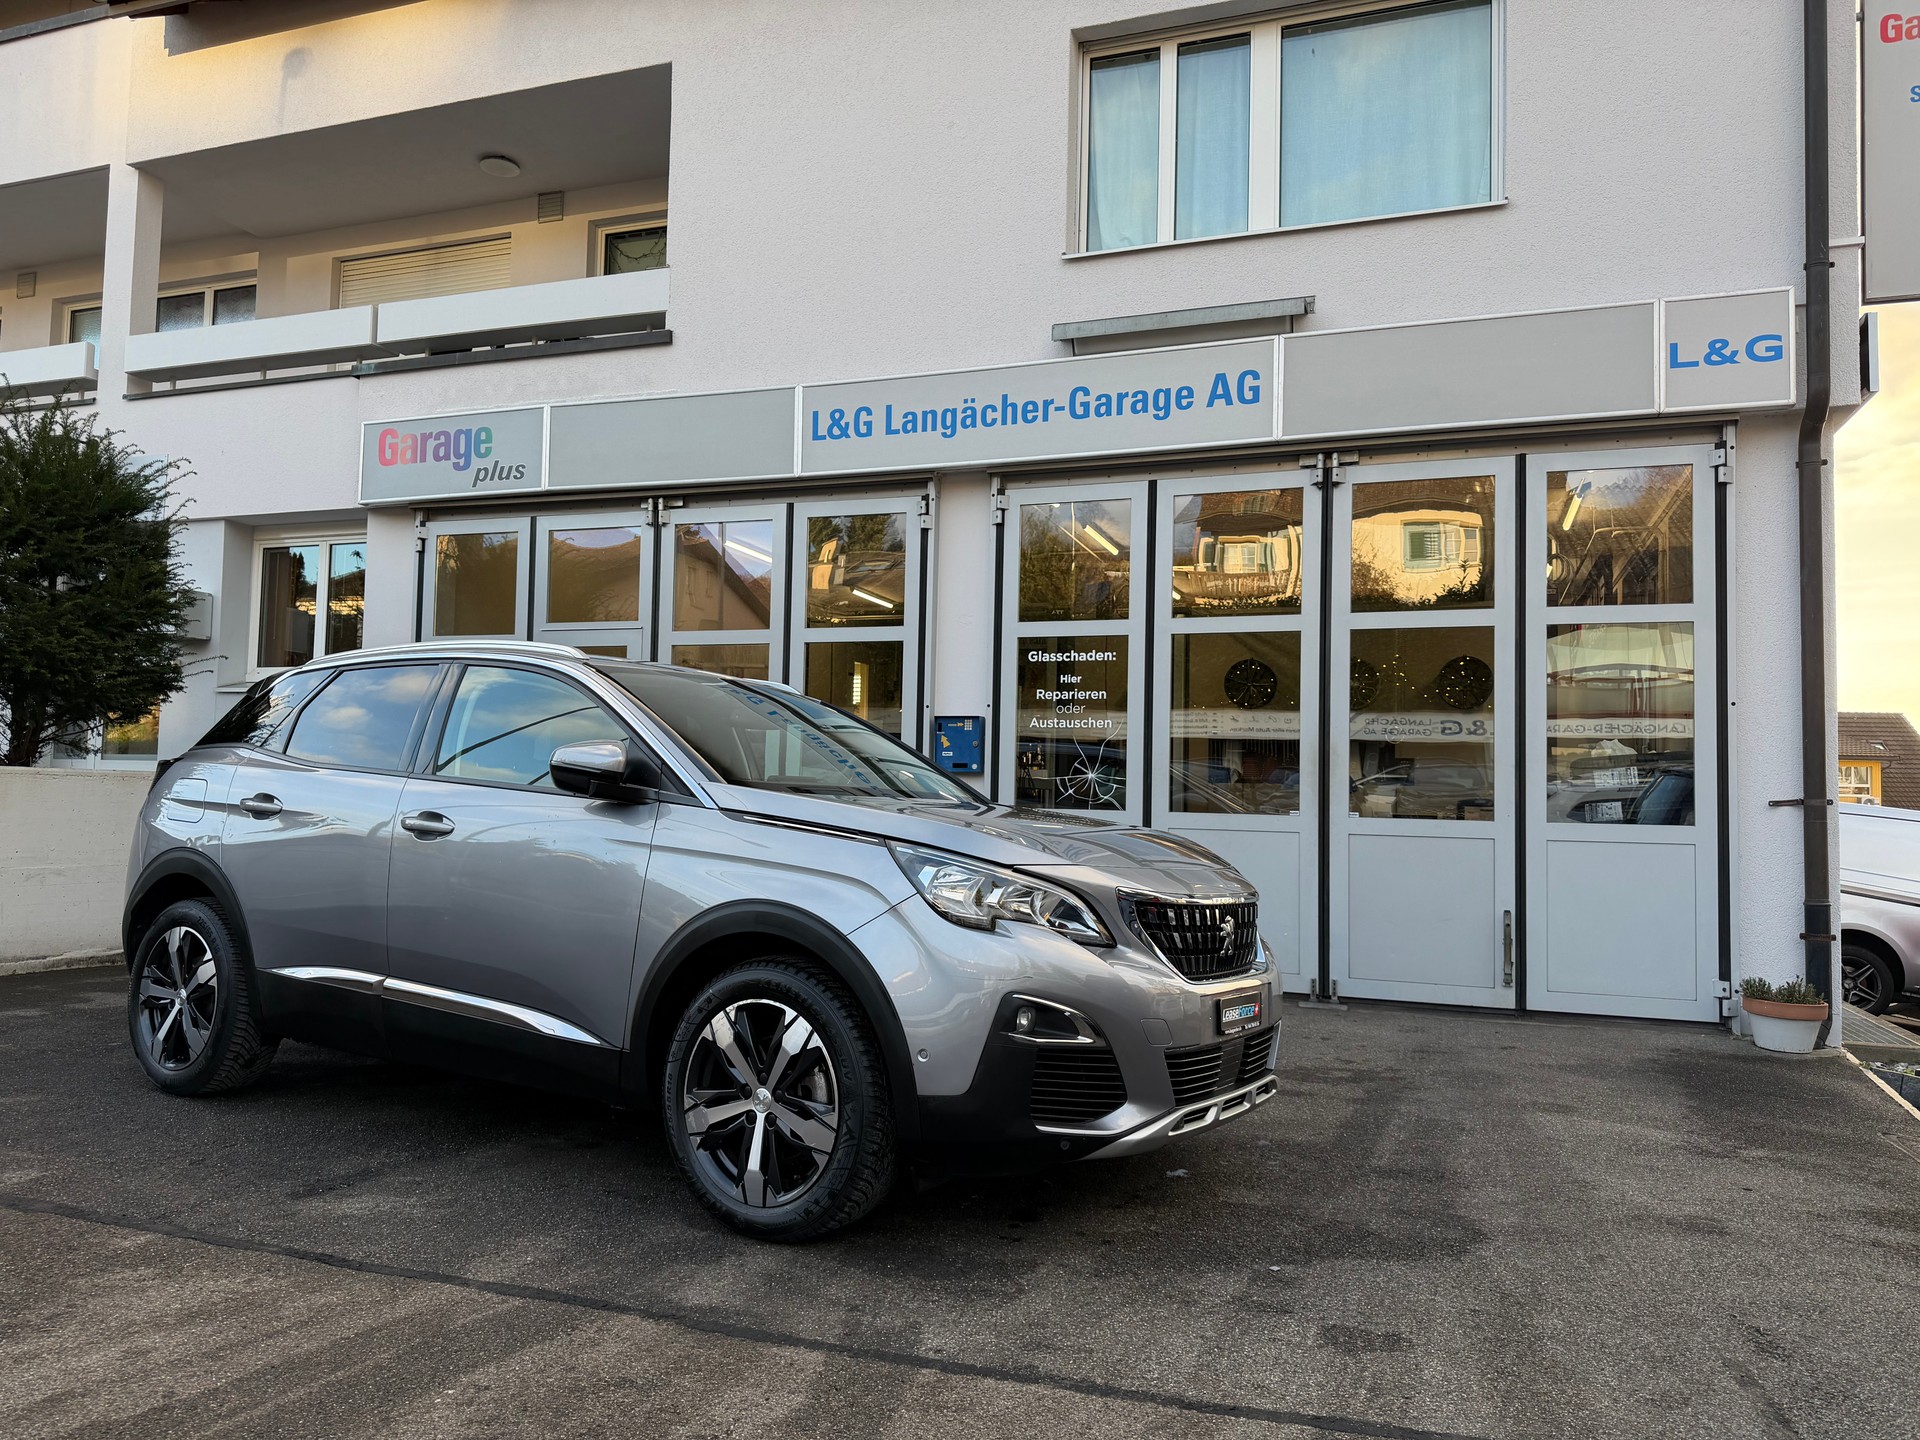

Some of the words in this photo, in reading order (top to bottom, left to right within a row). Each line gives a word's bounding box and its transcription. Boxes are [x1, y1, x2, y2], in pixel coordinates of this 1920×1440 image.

[1669, 333, 1784, 369] L&G
[811, 405, 874, 442] L&G
[885, 385, 1195, 439] Langächer-Garage
[1206, 369, 1261, 408] AG
[378, 426, 493, 471] Garage
[471, 459, 527, 488] plus
[1028, 650, 1117, 662] Glasschaden:
[1060, 674, 1082, 684] Hier
[1036, 688, 1107, 701] Reparieren
[1056, 703, 1086, 714] oder
[1029, 716, 1112, 729] Austauschen
